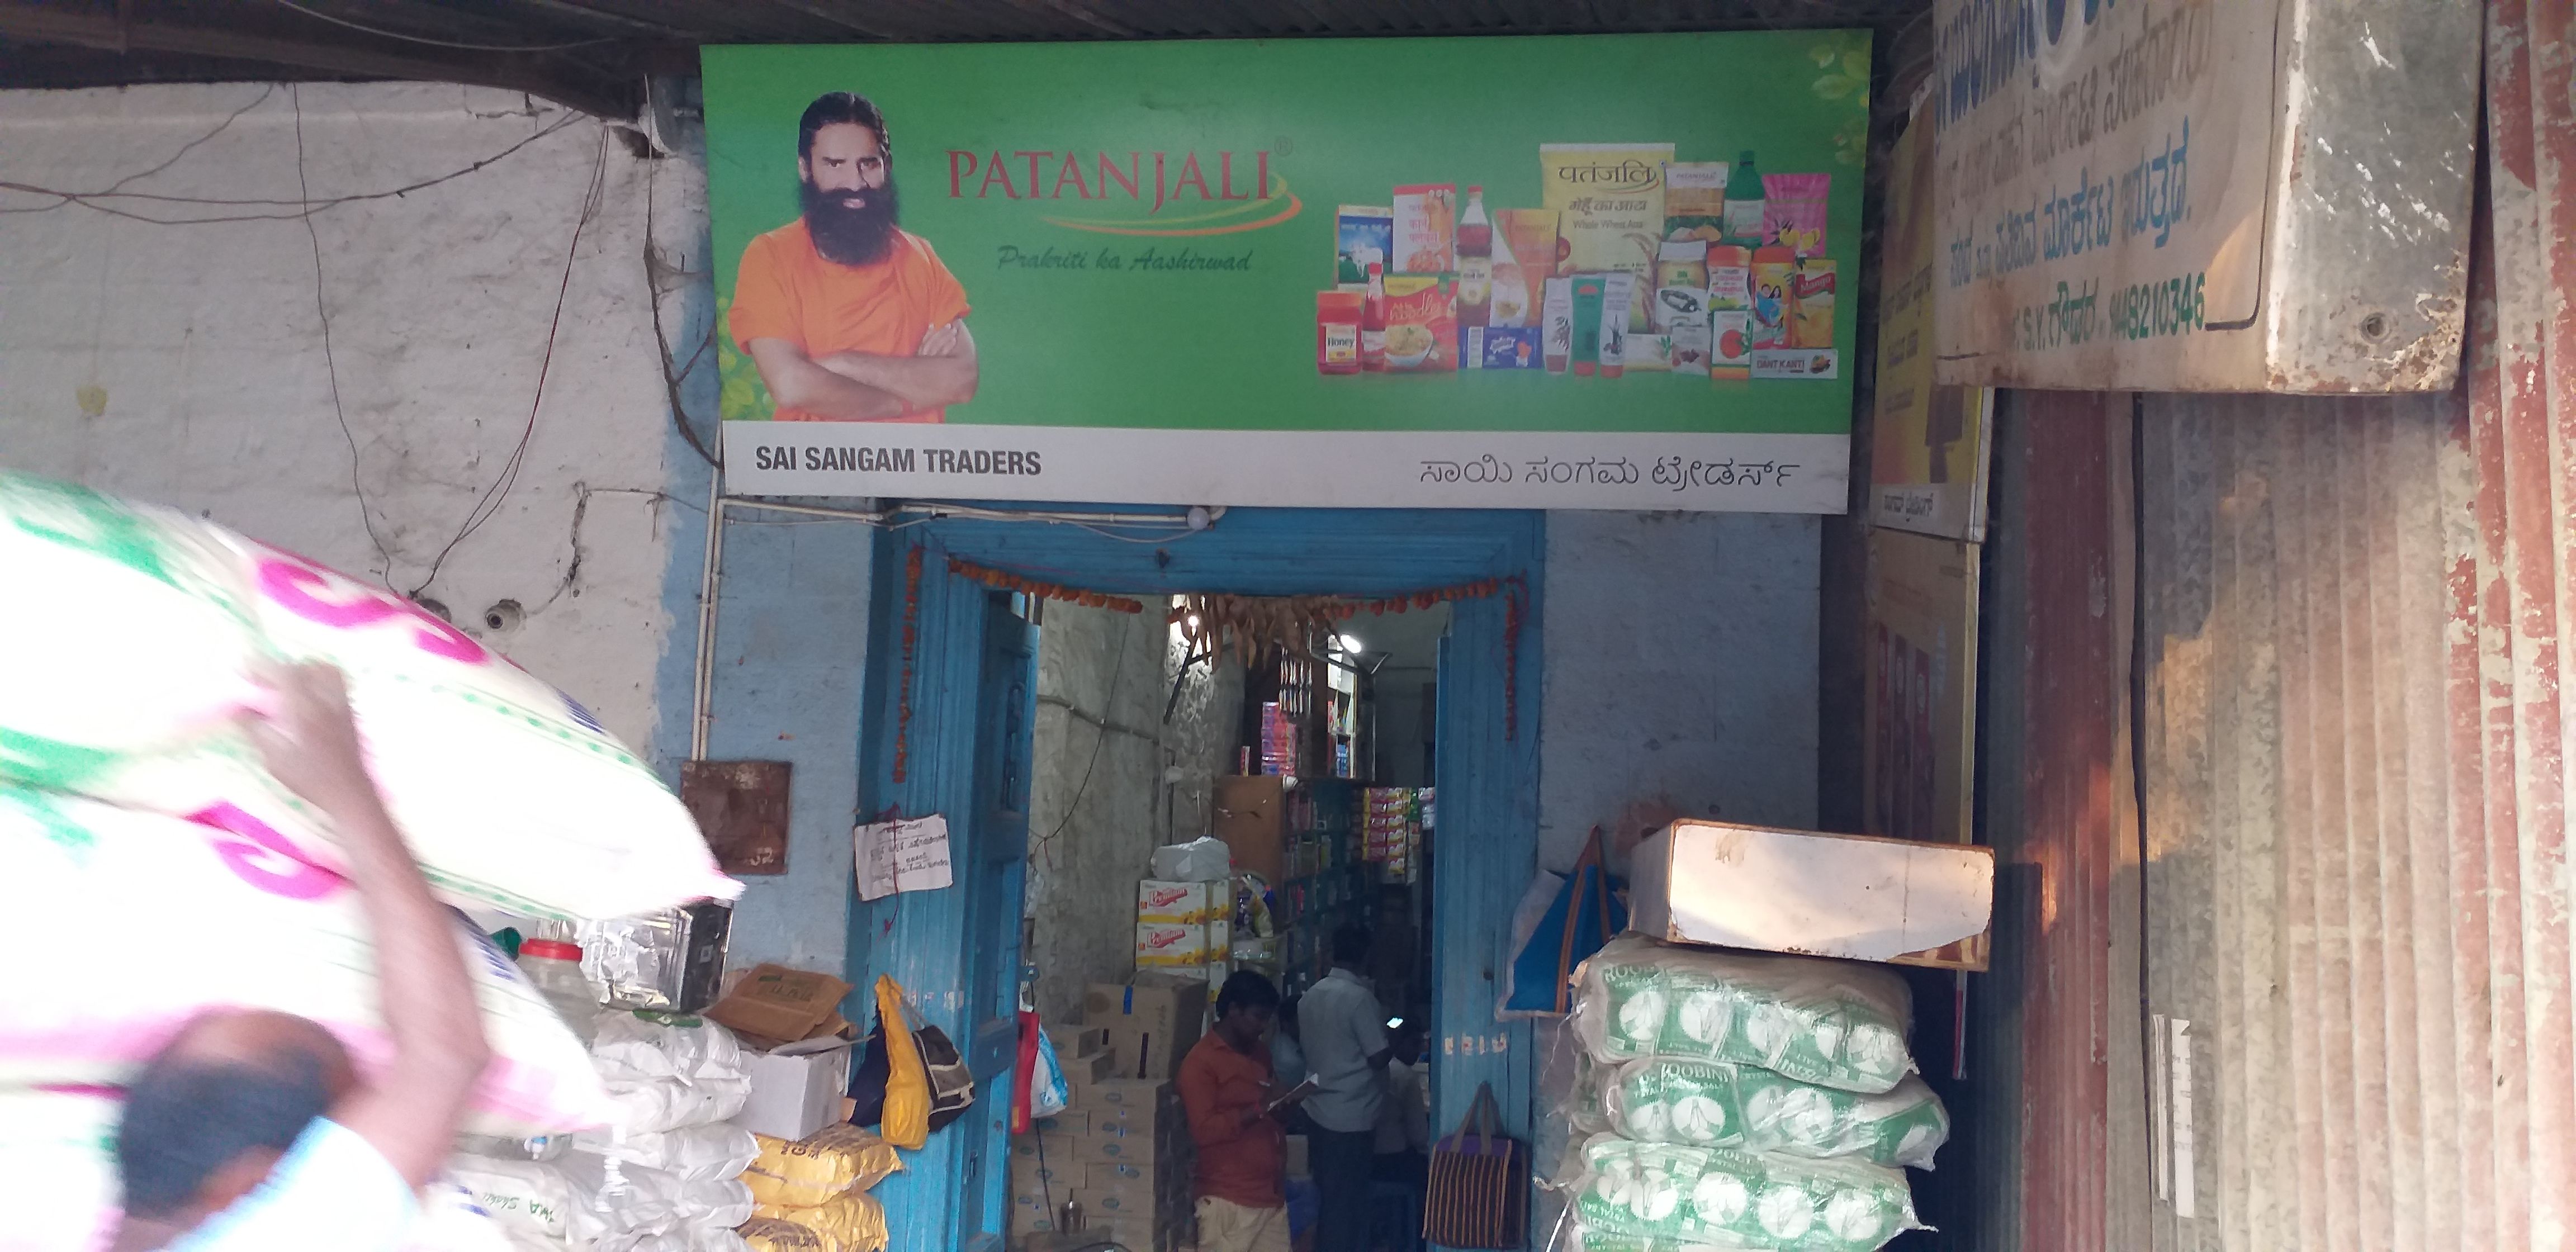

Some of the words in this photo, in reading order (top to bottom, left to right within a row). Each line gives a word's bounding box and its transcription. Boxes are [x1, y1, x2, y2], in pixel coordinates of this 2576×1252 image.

[945, 149, 1272, 216] PATANJALI
[1558, 160, 1657, 183] पतंजलि
[997, 244, 1088, 271] Prakriti
[1096, 245, 1122, 270] ka
[1129, 246, 1253, 272] Aashirwad
[1327, 336, 1355, 349] Honey
[756, 445, 797, 471] SAI
[805, 447, 915, 473] SANGAM
[923, 449, 1042, 476] TRADERS
[1420, 453, 1513, 484] ಸಾಯಿ
[1525, 456, 1639, 486] ಸಂಗಮ
